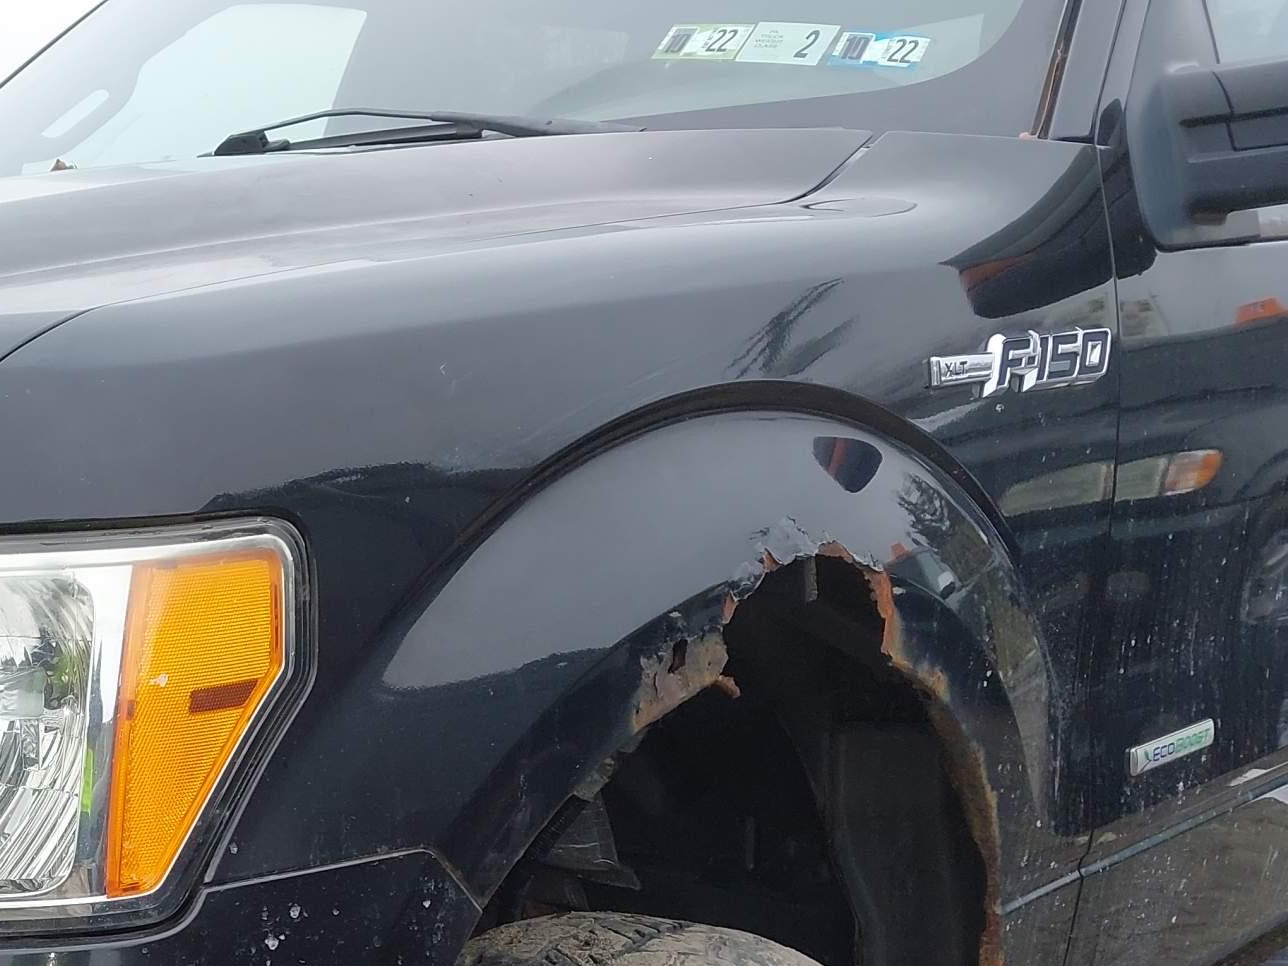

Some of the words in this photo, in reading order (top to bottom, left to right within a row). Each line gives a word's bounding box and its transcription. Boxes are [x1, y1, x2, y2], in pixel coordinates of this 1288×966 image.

[705, 28, 739, 53] 22
[792, 28, 821, 59] 2
[886, 38, 920, 64] 22
[944, 359, 969, 378] XLT
